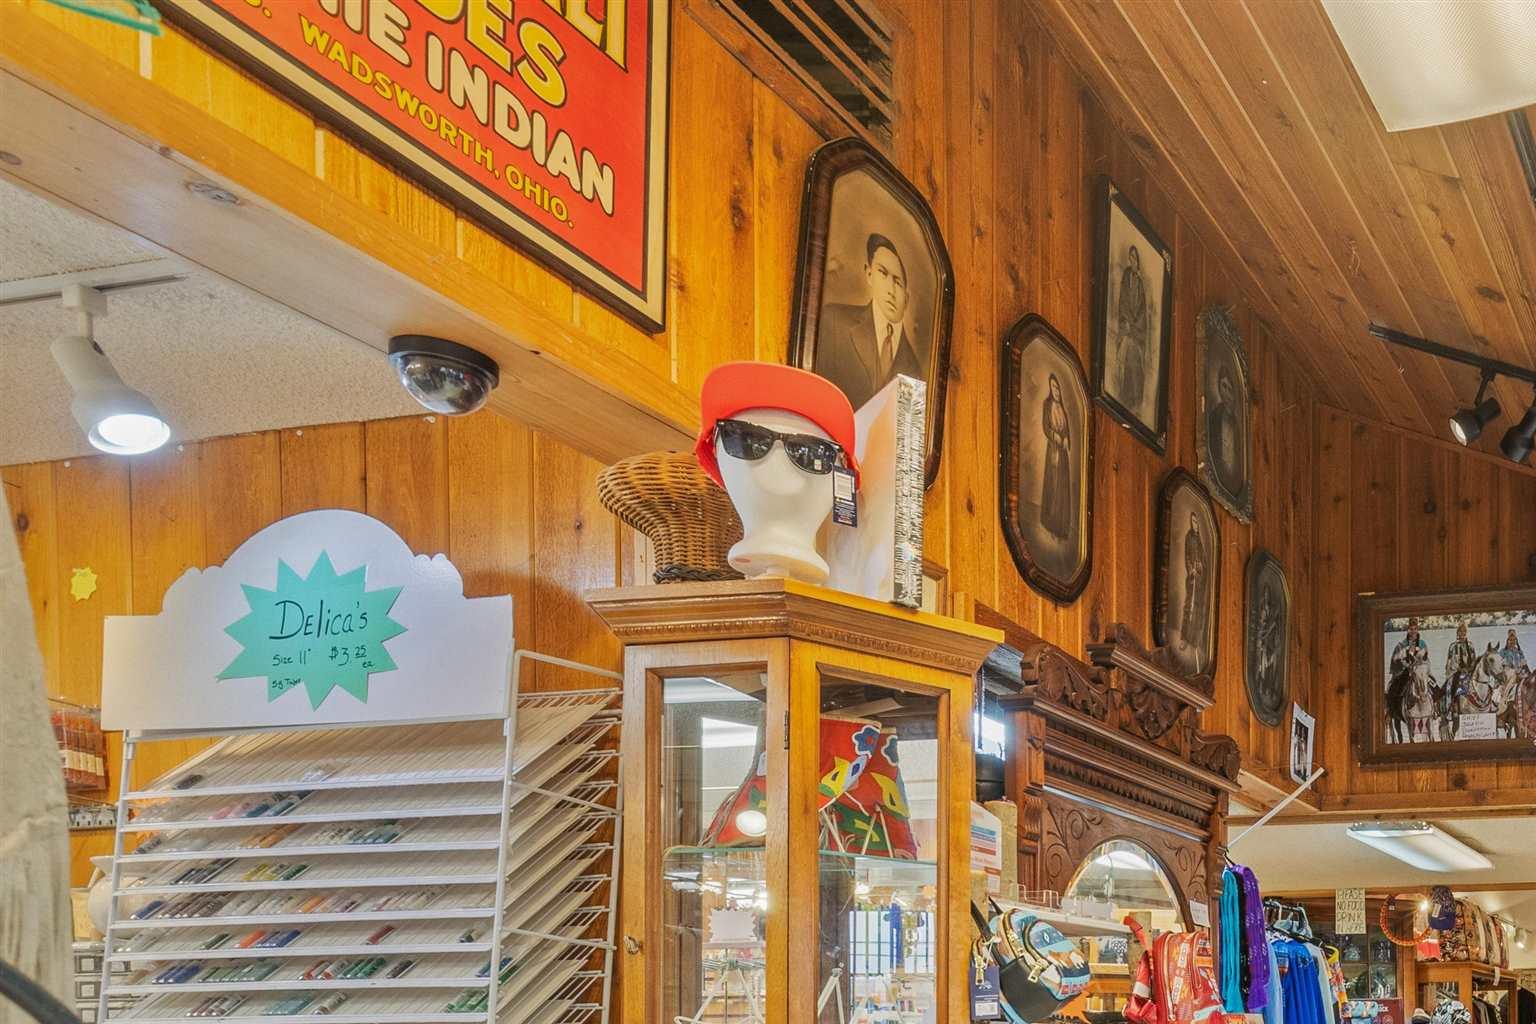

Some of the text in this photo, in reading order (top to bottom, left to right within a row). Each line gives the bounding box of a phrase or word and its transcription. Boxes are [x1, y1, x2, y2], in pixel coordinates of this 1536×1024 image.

[298, 14, 575, 228] WADSWORTH, OHIO.
[427, 32, 615, 217] INDIAN
